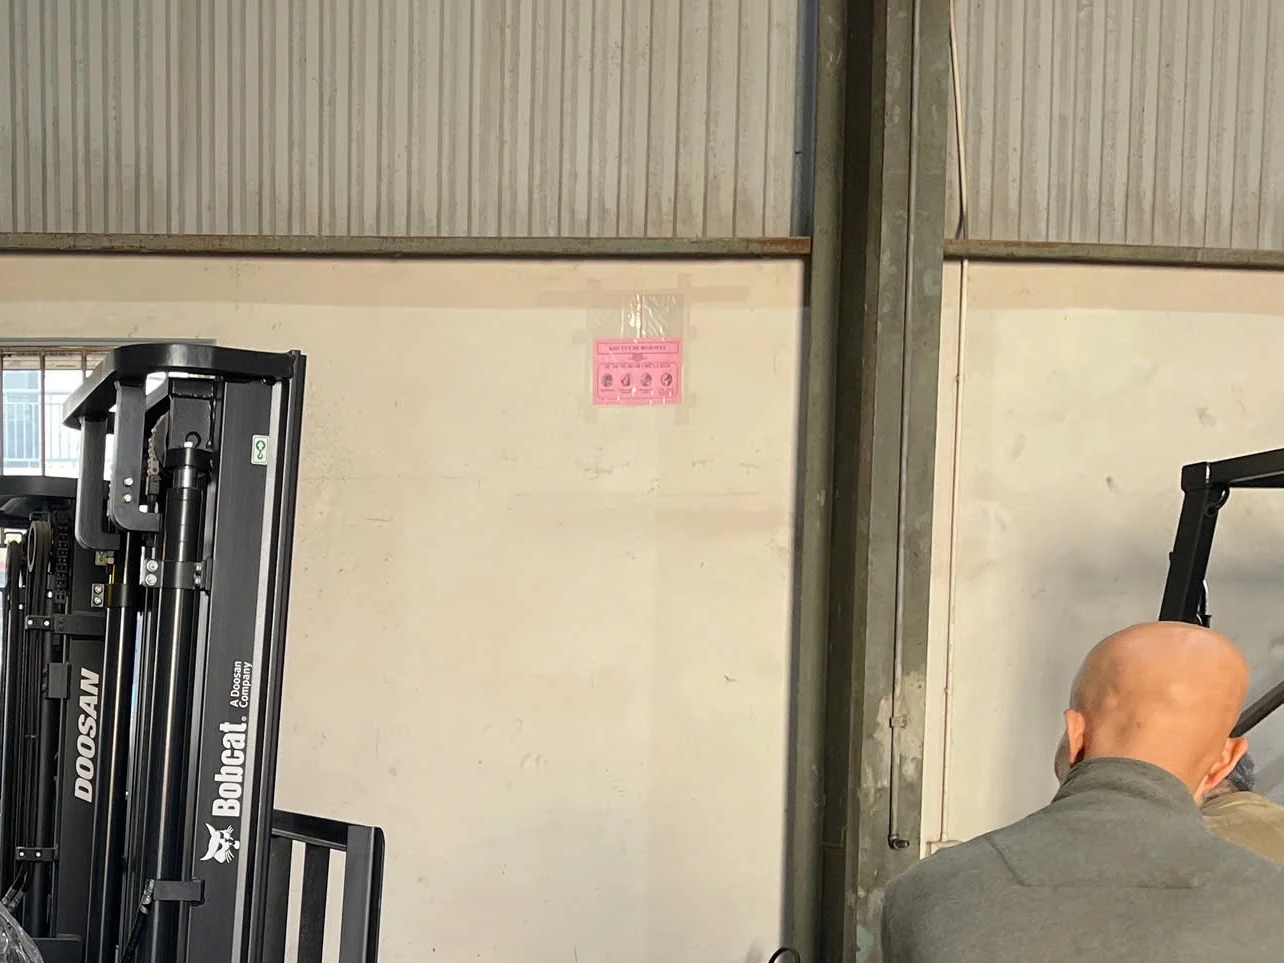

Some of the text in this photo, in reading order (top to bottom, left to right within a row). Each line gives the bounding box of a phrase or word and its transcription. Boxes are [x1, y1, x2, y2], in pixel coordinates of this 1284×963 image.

[229, 660, 242, 708] A Doosan
[238, 661, 253, 709] Company
[74, 667, 100, 803] DOOSAN
